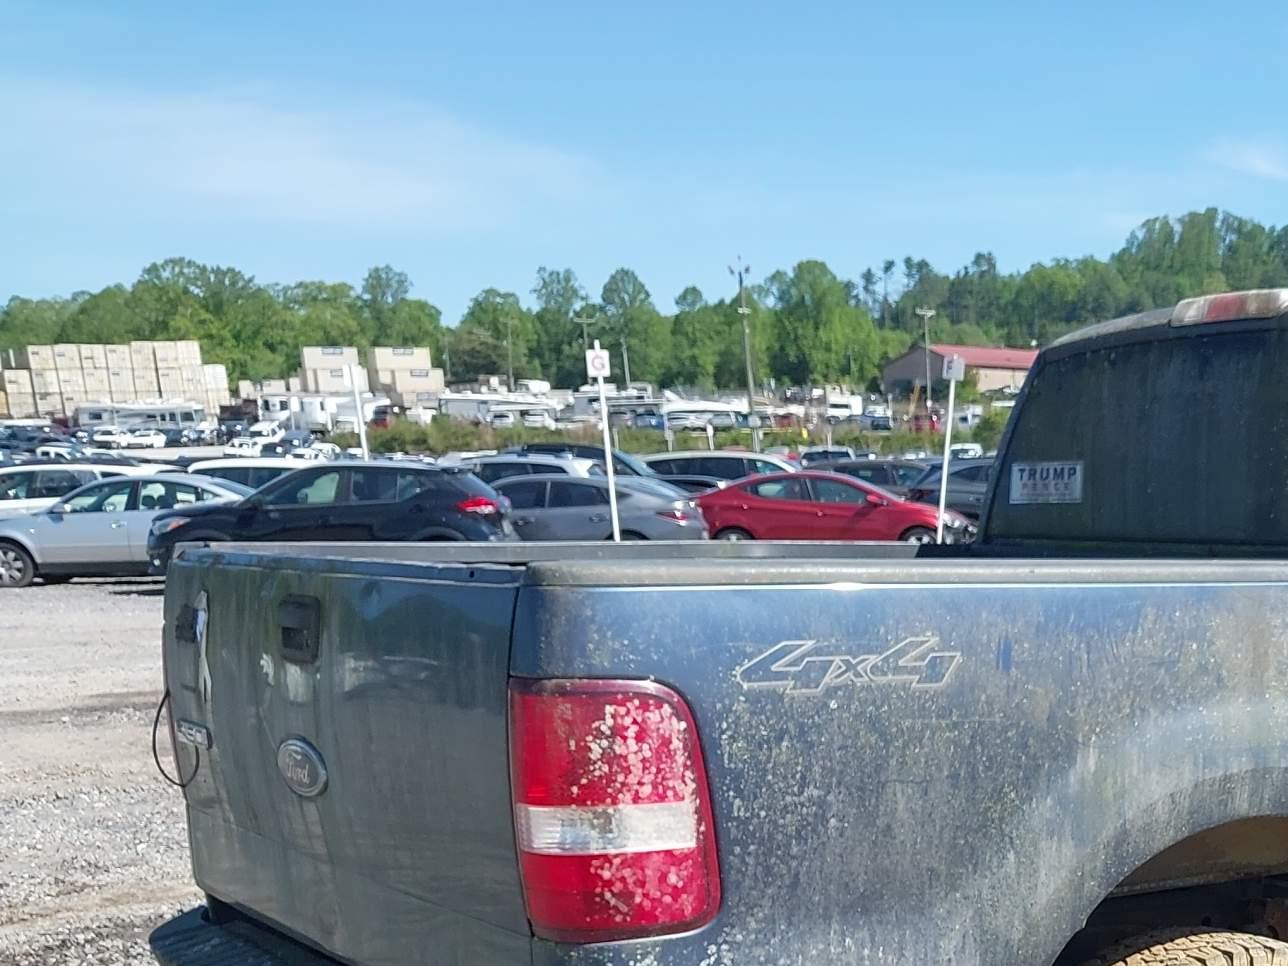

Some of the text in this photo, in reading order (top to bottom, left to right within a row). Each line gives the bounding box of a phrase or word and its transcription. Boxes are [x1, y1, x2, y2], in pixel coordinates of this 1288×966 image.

[591, 354, 606, 371] G
[1018, 466, 1077, 481] TRUMP
[737, 636, 962, 693] 4x4
